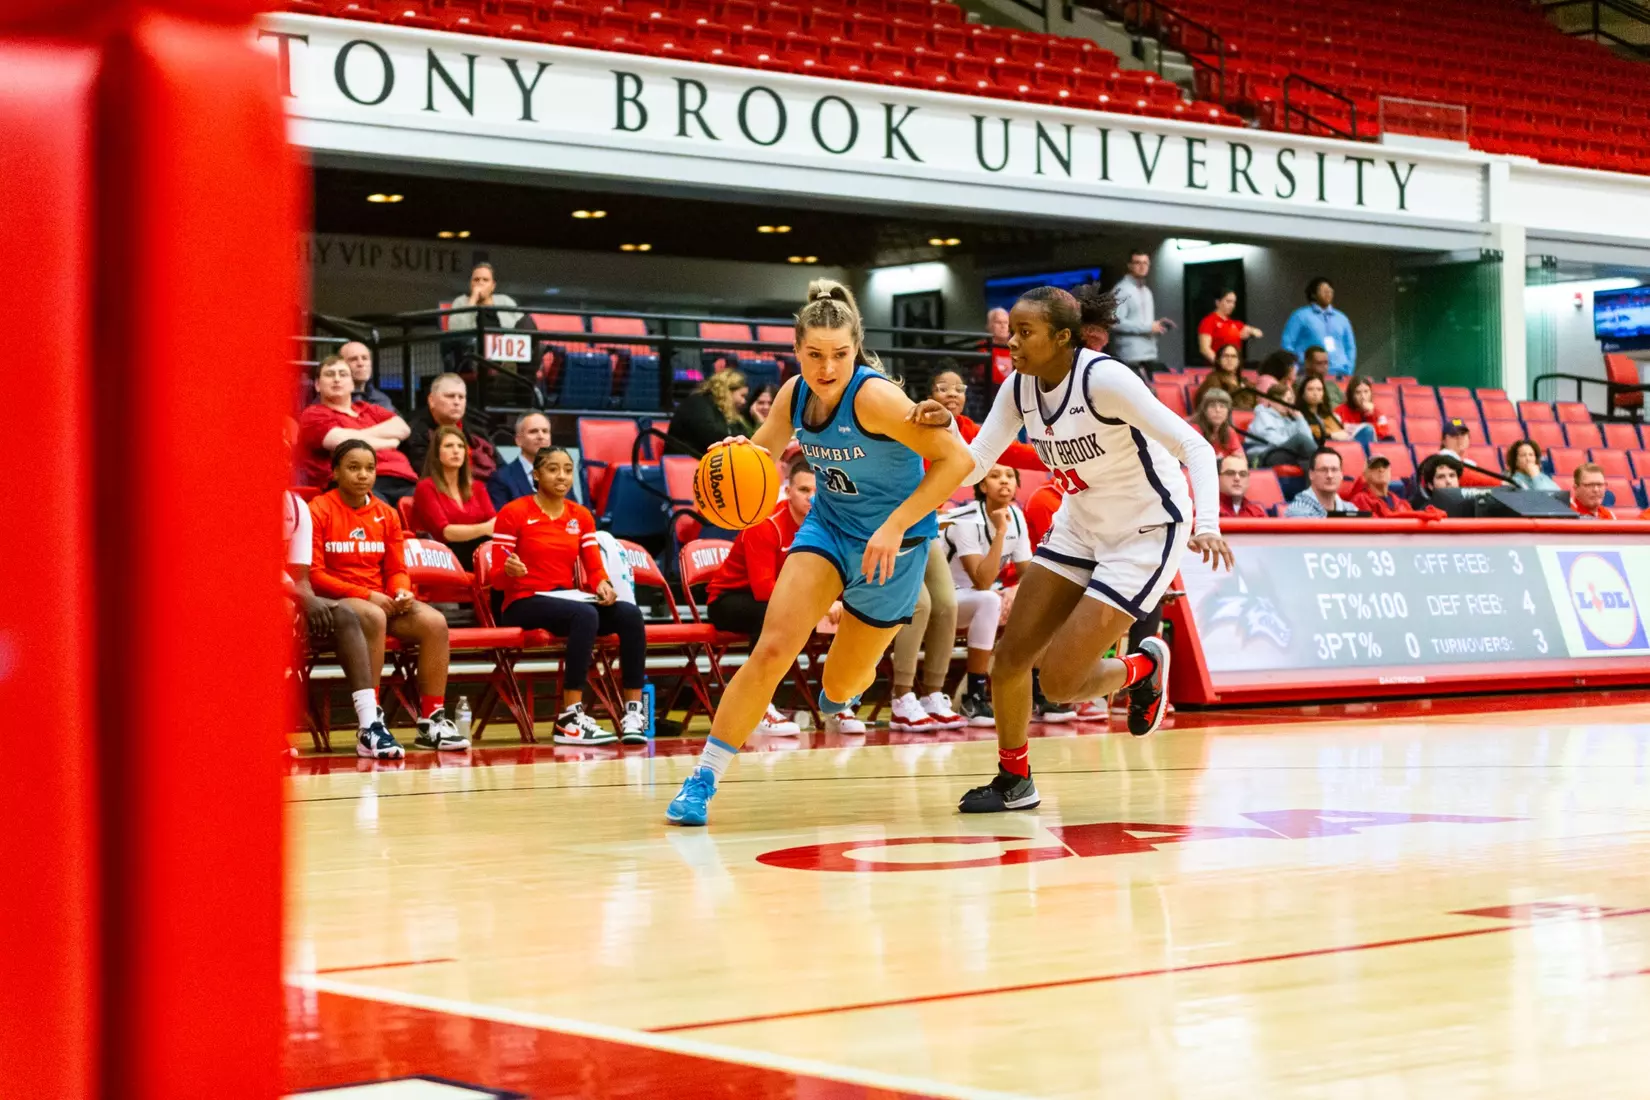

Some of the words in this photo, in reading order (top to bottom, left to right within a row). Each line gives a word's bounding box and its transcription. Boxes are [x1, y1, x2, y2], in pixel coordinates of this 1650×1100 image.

[257, 28, 553, 122] TONY
[609, 69, 926, 163] BROOK
[972, 114, 1419, 212] UNIVERSITY
[339, 239, 383, 267] VIP
[390, 242, 463, 273] SUITE
[497, 337, 527, 358] 102
[1069, 406, 1086, 415] CAA
[1055, 432, 1106, 465] BROOK
[709, 453, 726, 510] Wilson
[1053, 468, 1090, 495] 21
[325, 541, 355, 553] STONY
[421, 547, 456, 571] BROOK
[691, 548, 720, 570] STONY
[1303, 551, 1362, 580] FG%
[1367, 550, 1397, 578] 39
[1414, 553, 1449, 575] OFF
[1454, 553, 1497, 574] REB:
[1508, 549, 1525, 576] 3
[1426, 594, 1462, 617] DEF
[1465, 593, 1508, 616] REB:
[1523, 589, 1537, 616] 4
[1313, 631, 1383, 661] 3PT%
[1404, 631, 1422, 660] 0
[1431, 636, 1516, 654] TURNOVERS:
[1532, 628, 1549, 654] 3
[753, 807, 1534, 873] CAA
